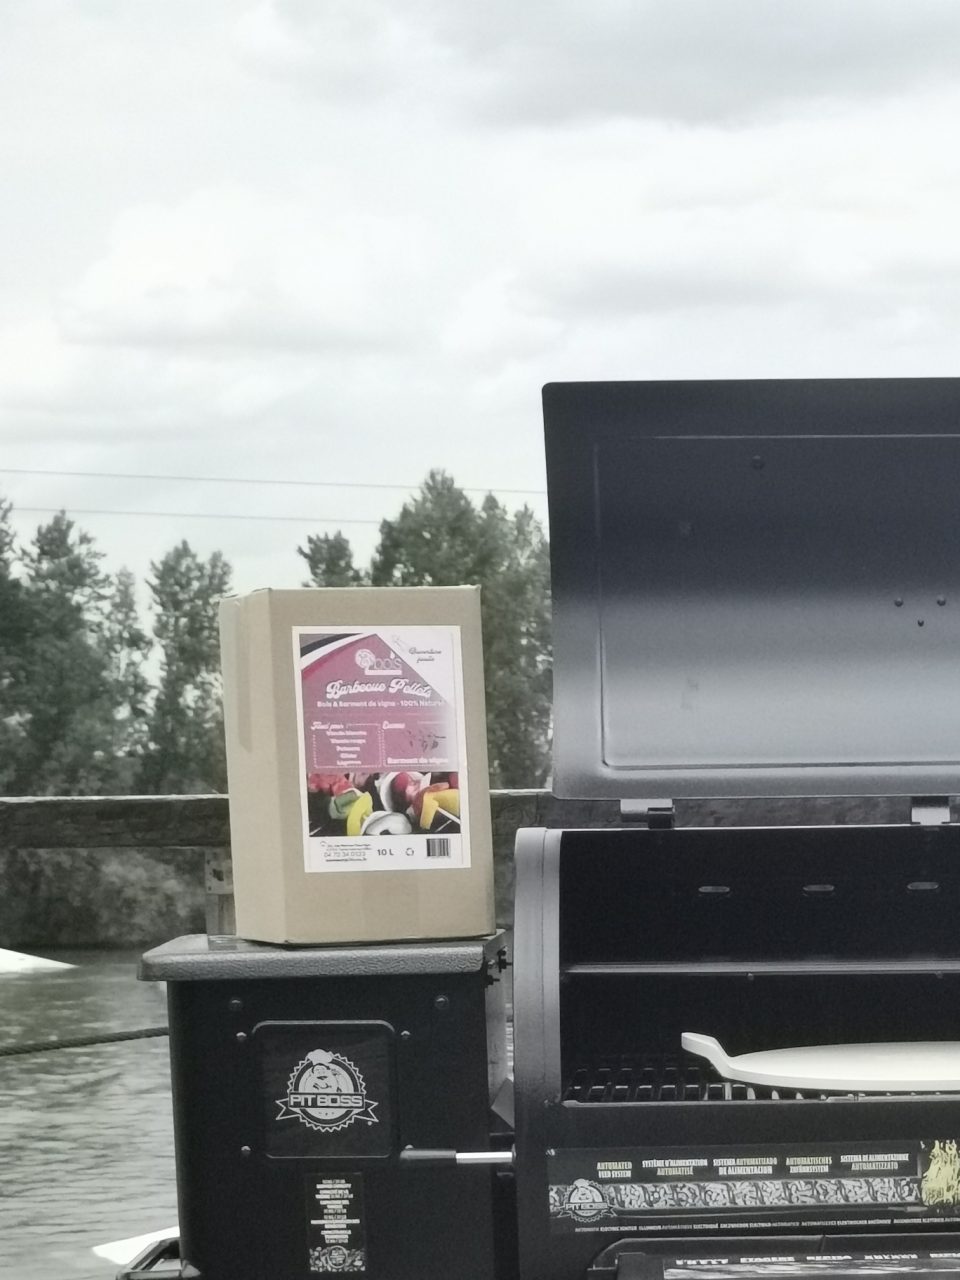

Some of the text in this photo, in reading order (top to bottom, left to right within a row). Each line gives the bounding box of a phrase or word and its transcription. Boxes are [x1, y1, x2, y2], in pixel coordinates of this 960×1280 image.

[326, 678, 432, 699] Barbecue Pellets
[377, 848, 394, 856] 10 L
[290, 1094, 362, 1107] PIT BOSS
